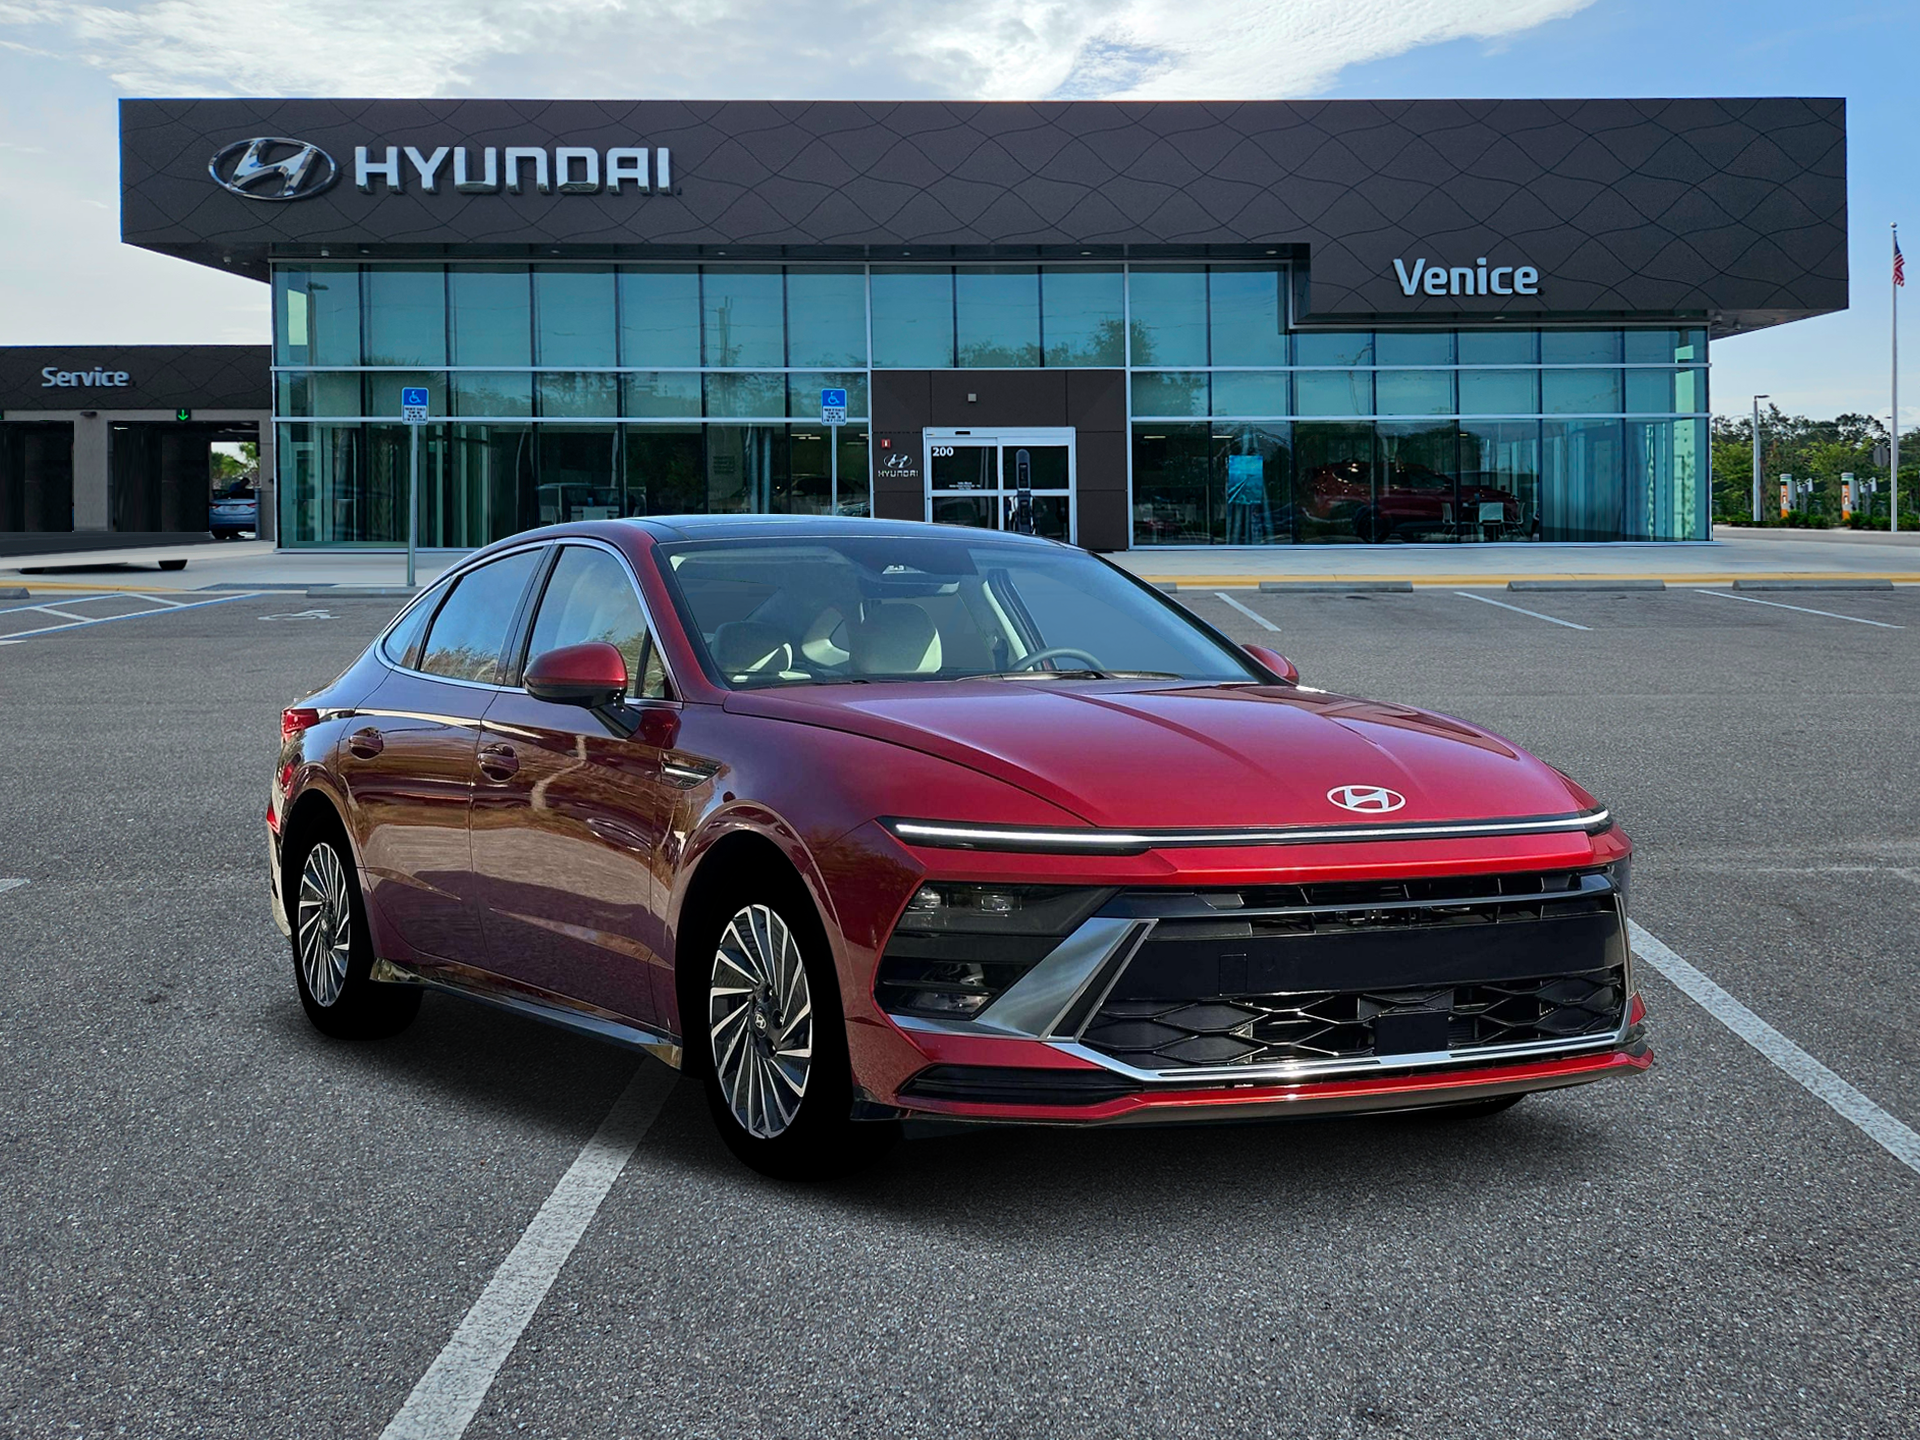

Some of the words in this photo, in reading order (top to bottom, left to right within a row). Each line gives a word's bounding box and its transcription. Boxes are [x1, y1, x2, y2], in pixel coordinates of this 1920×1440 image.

[354, 145, 672, 195] HYUNDAI
[1392, 256, 1540, 296] Venice
[41, 366, 131, 388] Service
[932, 447, 954, 457] 200
[877, 470, 919, 478] HYUNDAI
